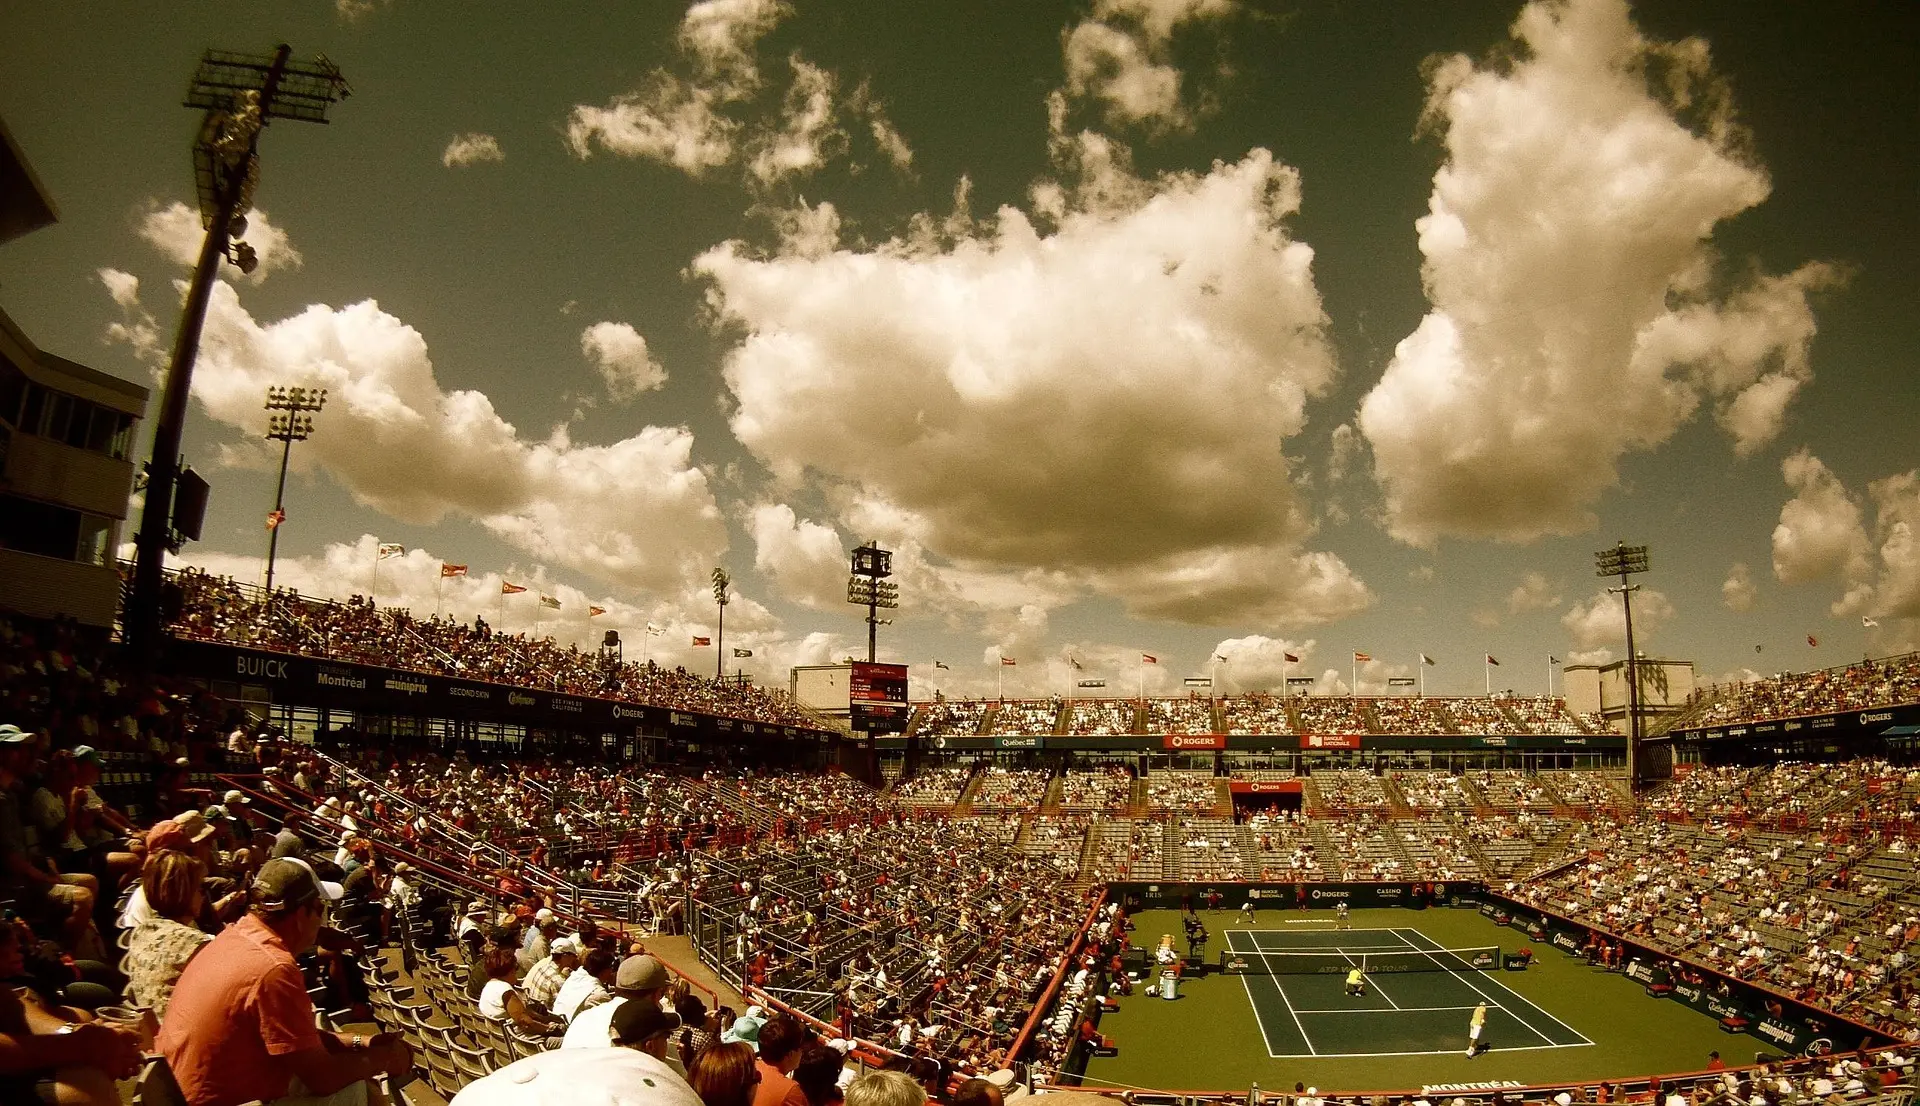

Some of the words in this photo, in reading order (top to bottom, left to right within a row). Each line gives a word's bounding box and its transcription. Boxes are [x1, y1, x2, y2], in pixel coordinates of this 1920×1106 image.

[236, 655, 289, 680] BUICK
[317, 672, 367, 690] Montréal
[394, 680, 429, 697] uniprix
[621, 708, 645, 719] ROGERS
[1867, 712, 1893, 722] ROGERS
[1002, 738, 1026, 747] Québec
[1144, 891, 1163, 899] IRIS
[1227, 961, 1249, 969] Corona
[1317, 966, 1339, 974] ATP
[1381, 964, 1408, 972] TOUR
[1764, 1022, 1797, 1045] uniprix
[1421, 1080, 1528, 1092] MONTRÉAL
